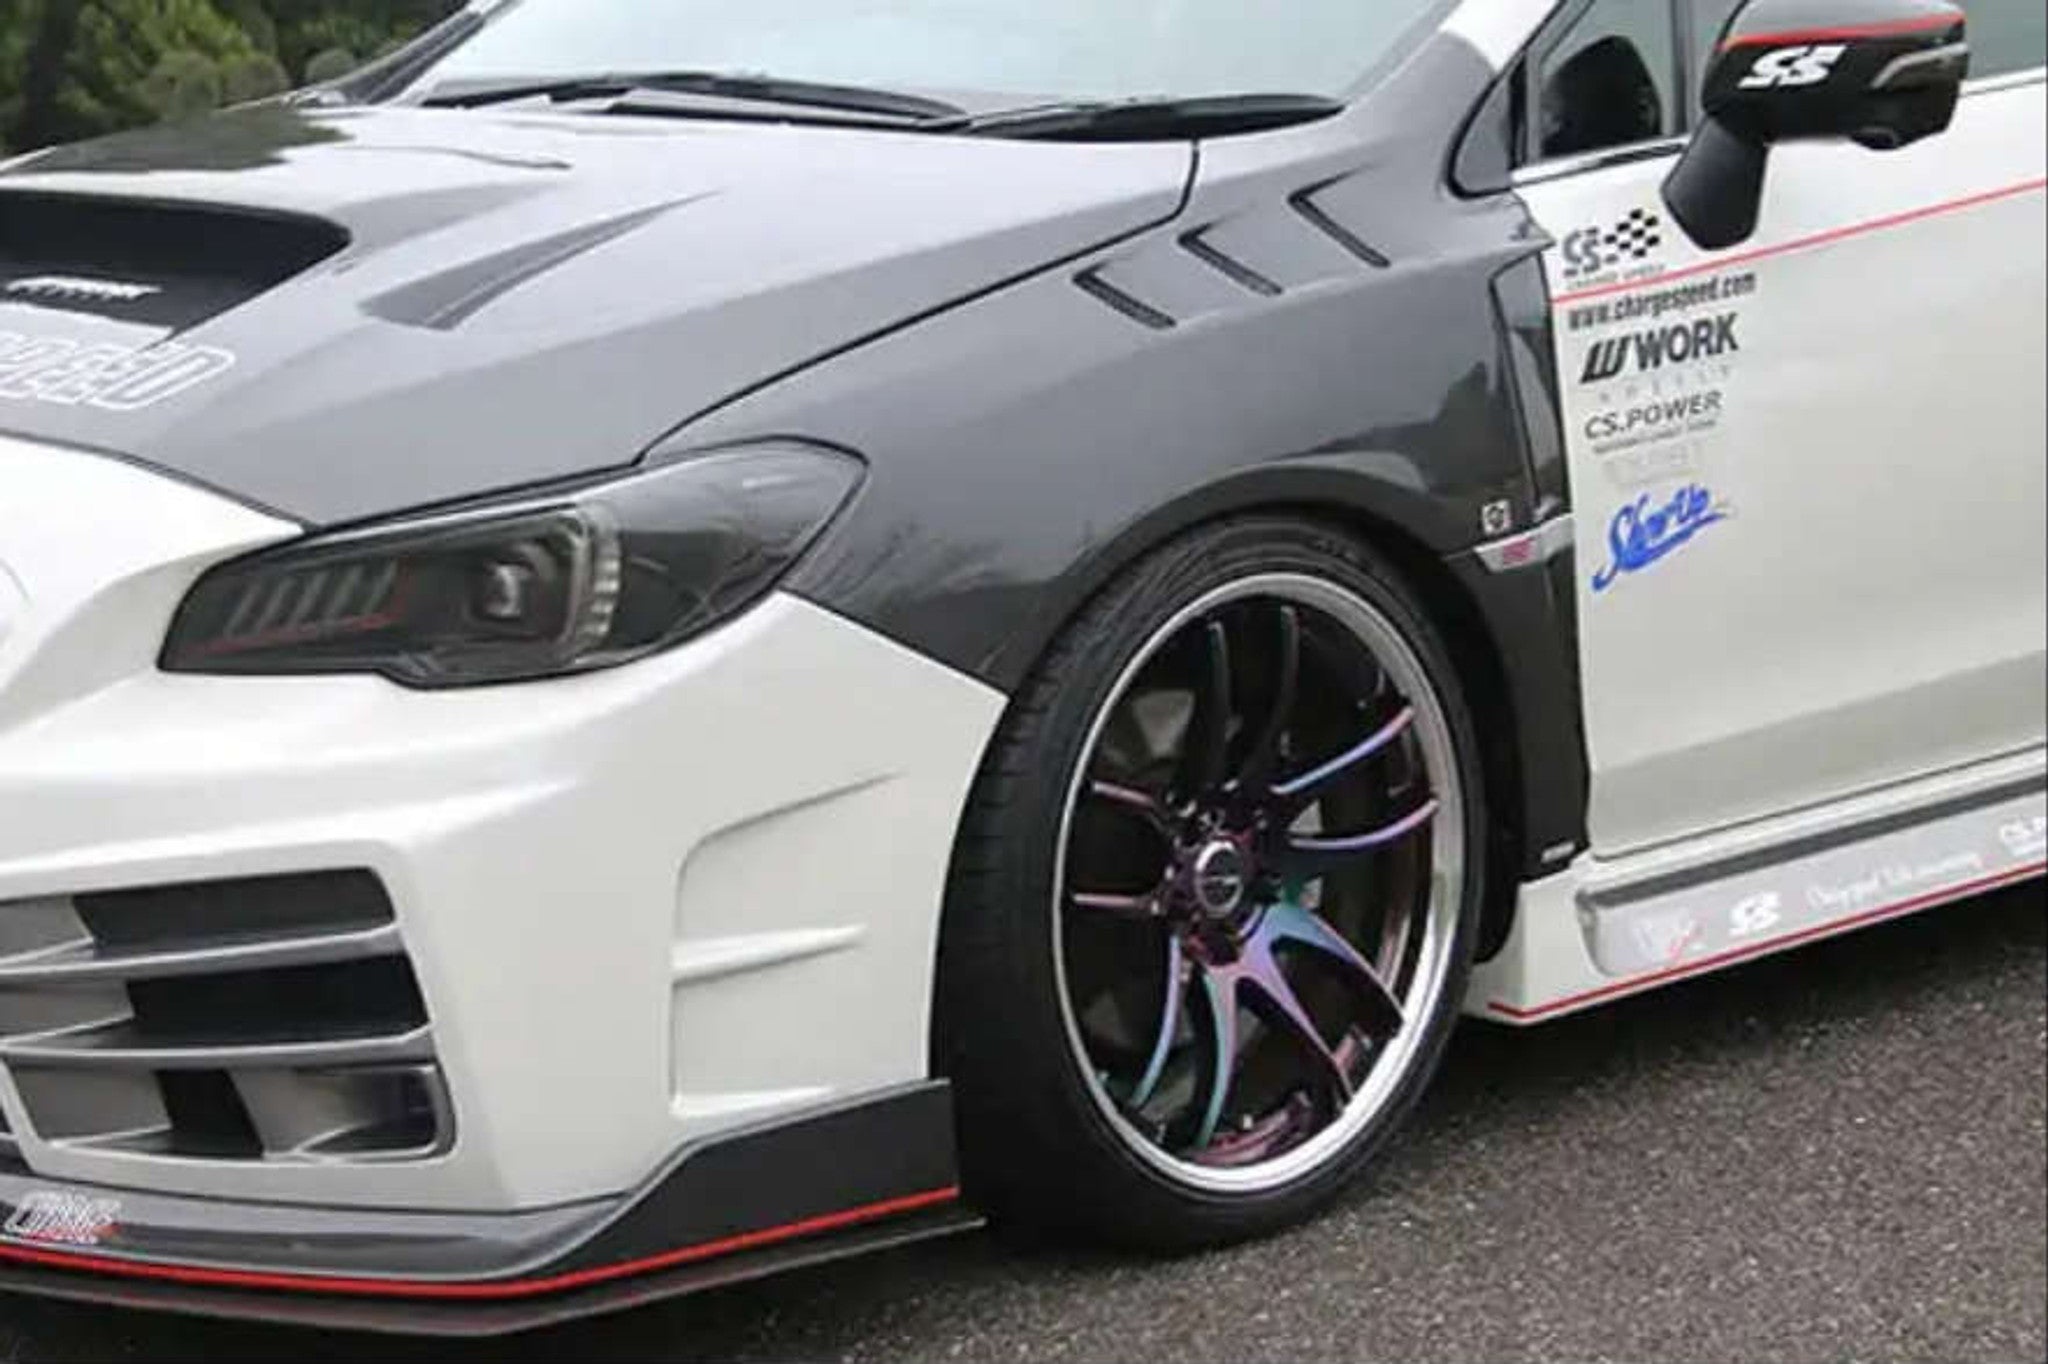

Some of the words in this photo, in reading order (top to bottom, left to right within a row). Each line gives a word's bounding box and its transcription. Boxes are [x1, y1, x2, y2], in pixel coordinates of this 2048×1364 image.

[1568, 272, 1756, 331] www.chargespeed.com
[1632, 312, 1739, 371] WORK
[1584, 389, 1723, 441] CS.POWER
